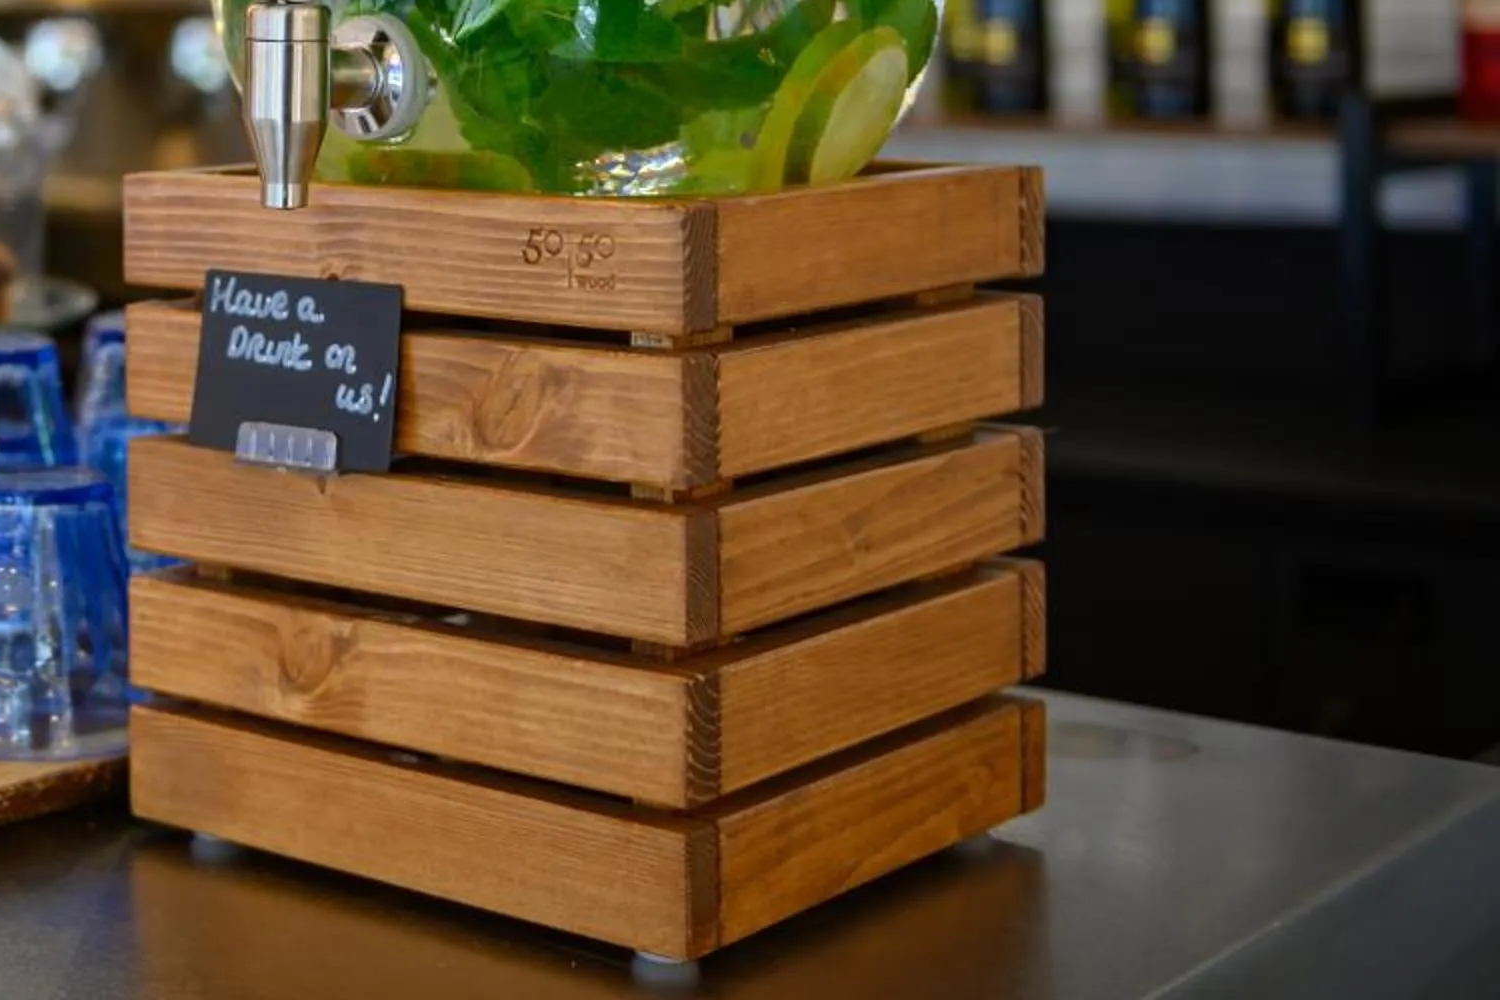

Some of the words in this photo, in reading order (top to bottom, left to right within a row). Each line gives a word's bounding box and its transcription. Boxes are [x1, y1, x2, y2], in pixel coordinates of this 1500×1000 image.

[522, 227, 563, 265] 50
[575, 232, 615, 268] 50
[210, 276, 289, 320] Have
[574, 273, 616, 291] wood
[324, 343, 357, 374] on
[335, 372, 393, 422] us!
